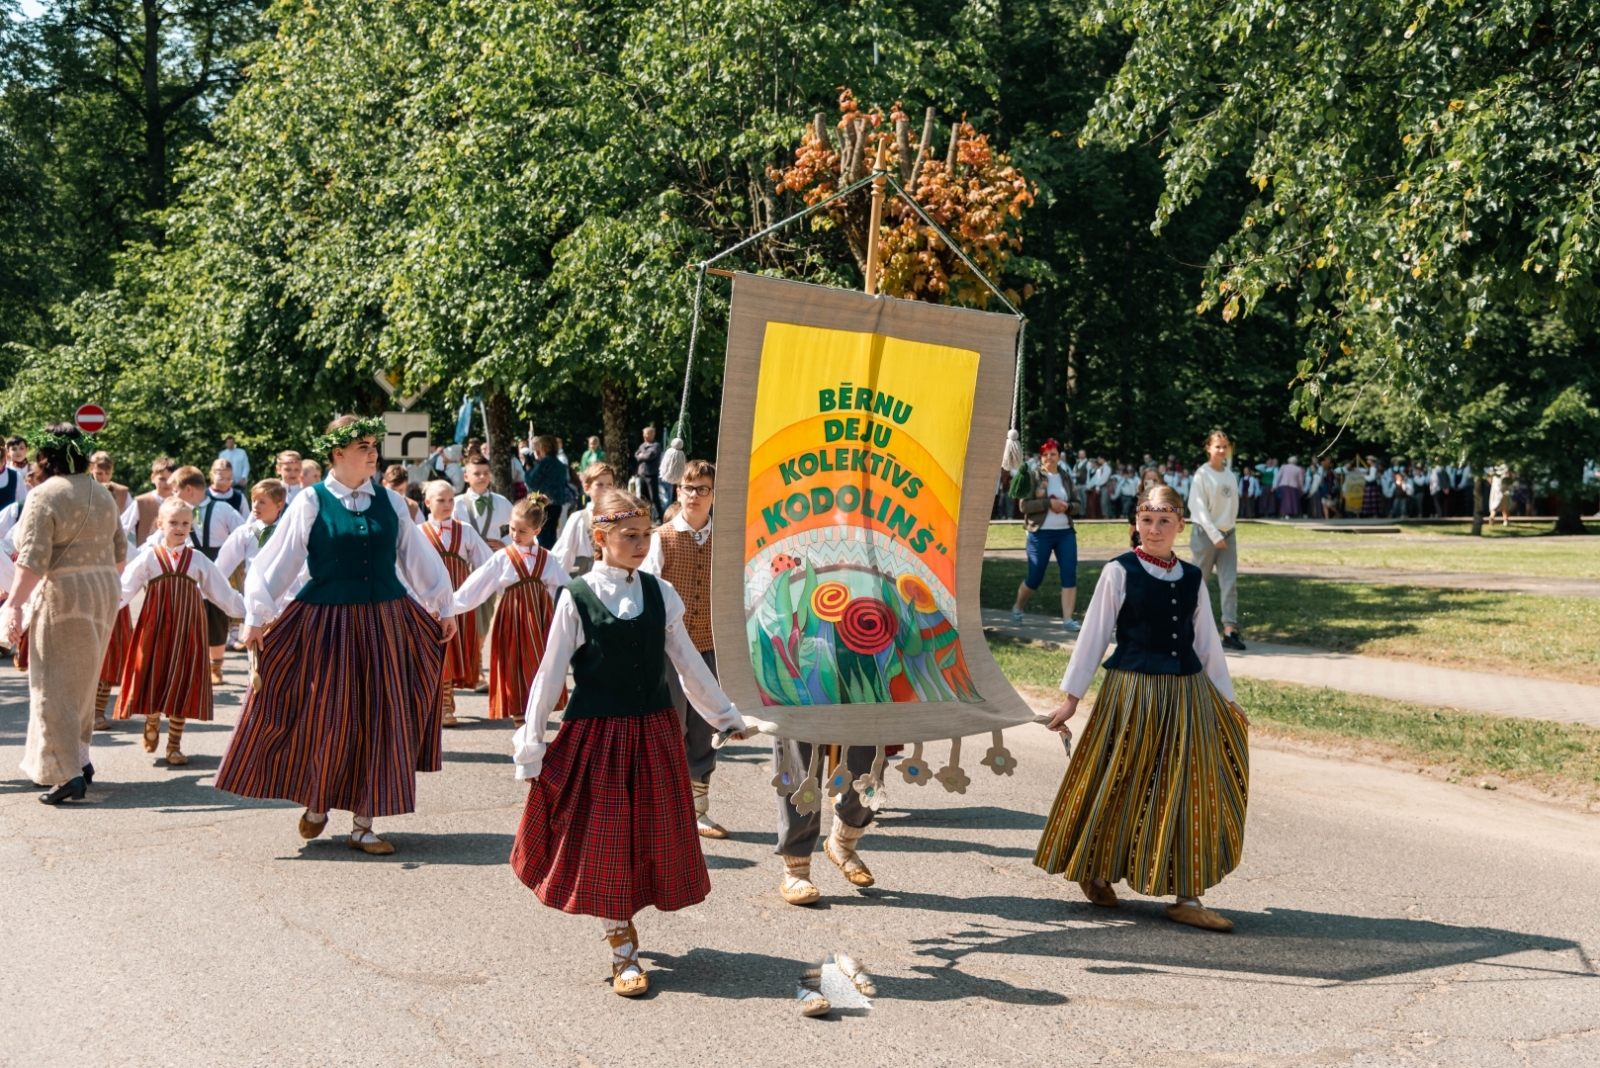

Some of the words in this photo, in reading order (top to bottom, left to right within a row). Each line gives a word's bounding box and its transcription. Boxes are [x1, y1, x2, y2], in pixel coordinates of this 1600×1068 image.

[818, 382, 913, 425] BĒRNU
[824, 417, 892, 448] DEJU
[778, 448, 924, 499] KOLEKTĪVS
